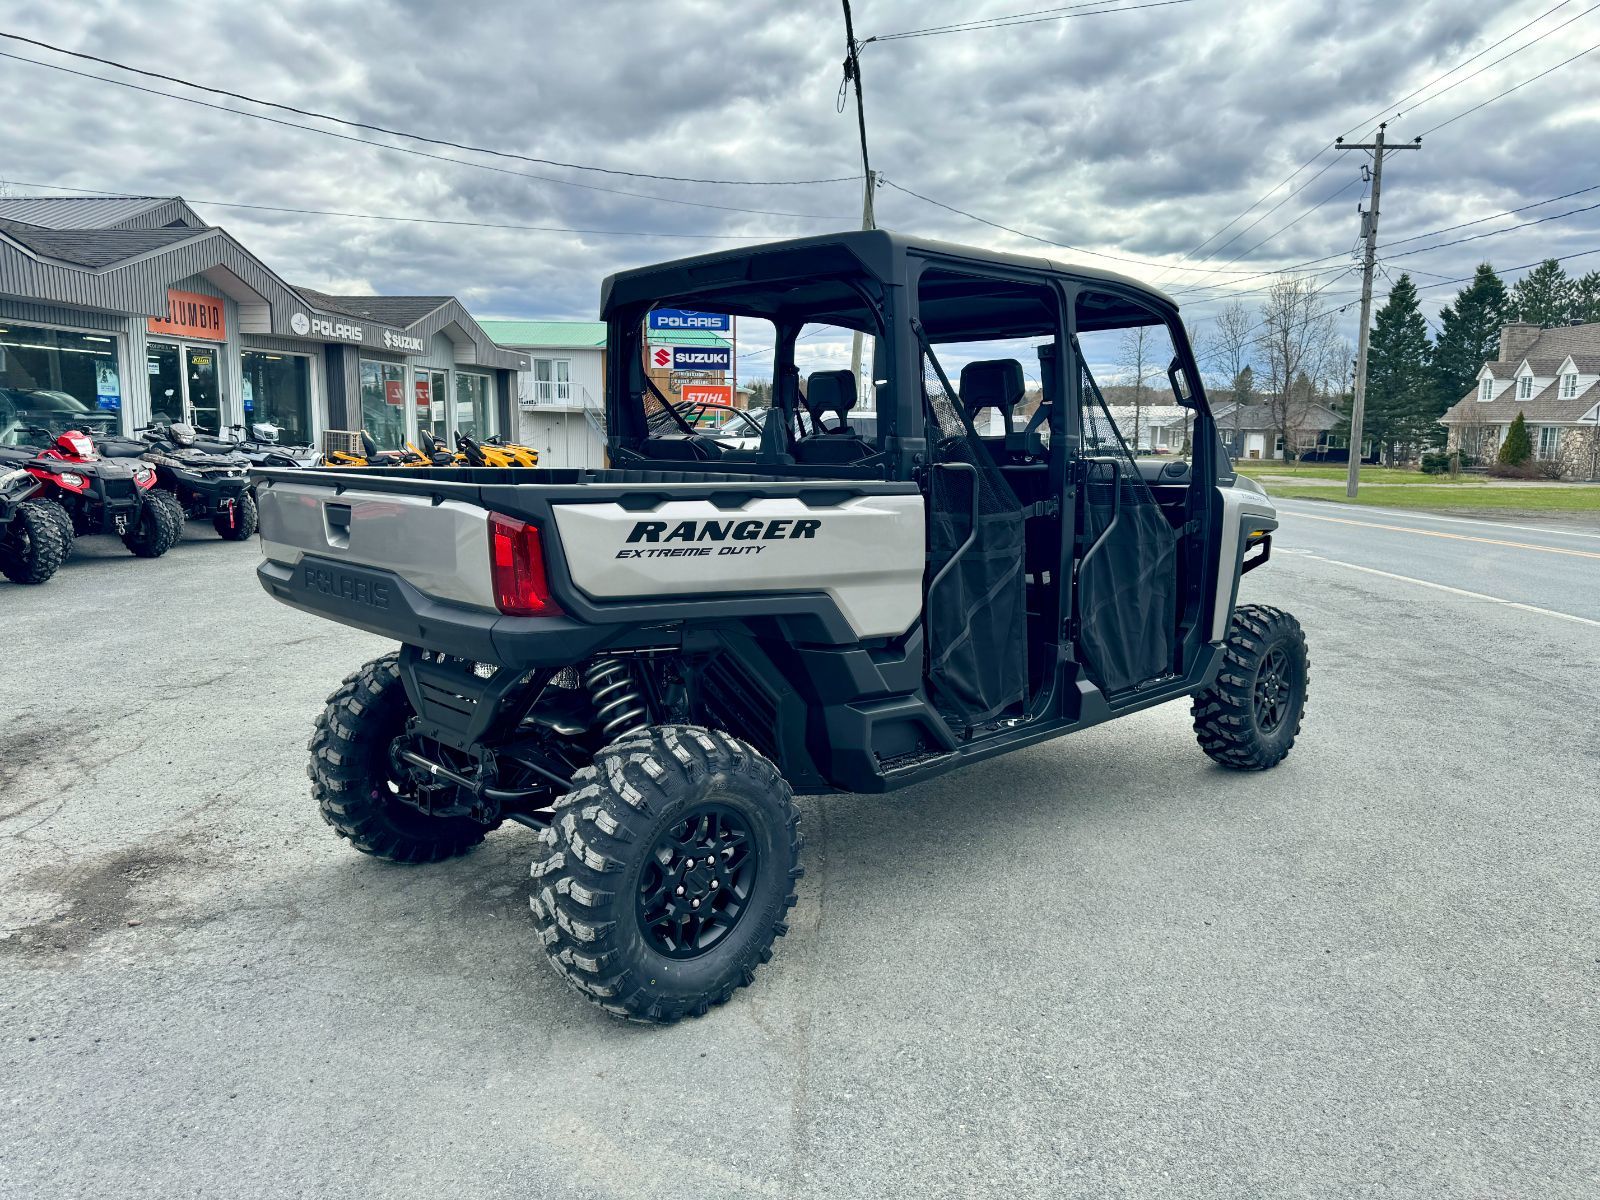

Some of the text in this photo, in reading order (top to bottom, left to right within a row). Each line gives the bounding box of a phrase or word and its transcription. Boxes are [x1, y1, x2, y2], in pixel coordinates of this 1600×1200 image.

[154, 300, 219, 330] LUMBIA
[658, 317, 722, 327] POLARIS
[312, 319, 362, 341] POLARIS
[392, 334, 423, 351] SUZUKI
[675, 353, 727, 363] SUZUKI
[688, 392, 726, 403] STIHL
[625, 519, 822, 543] RANGER
[615, 545, 767, 559] EXTREME DUTY
[305, 567, 389, 610] POLARIS
